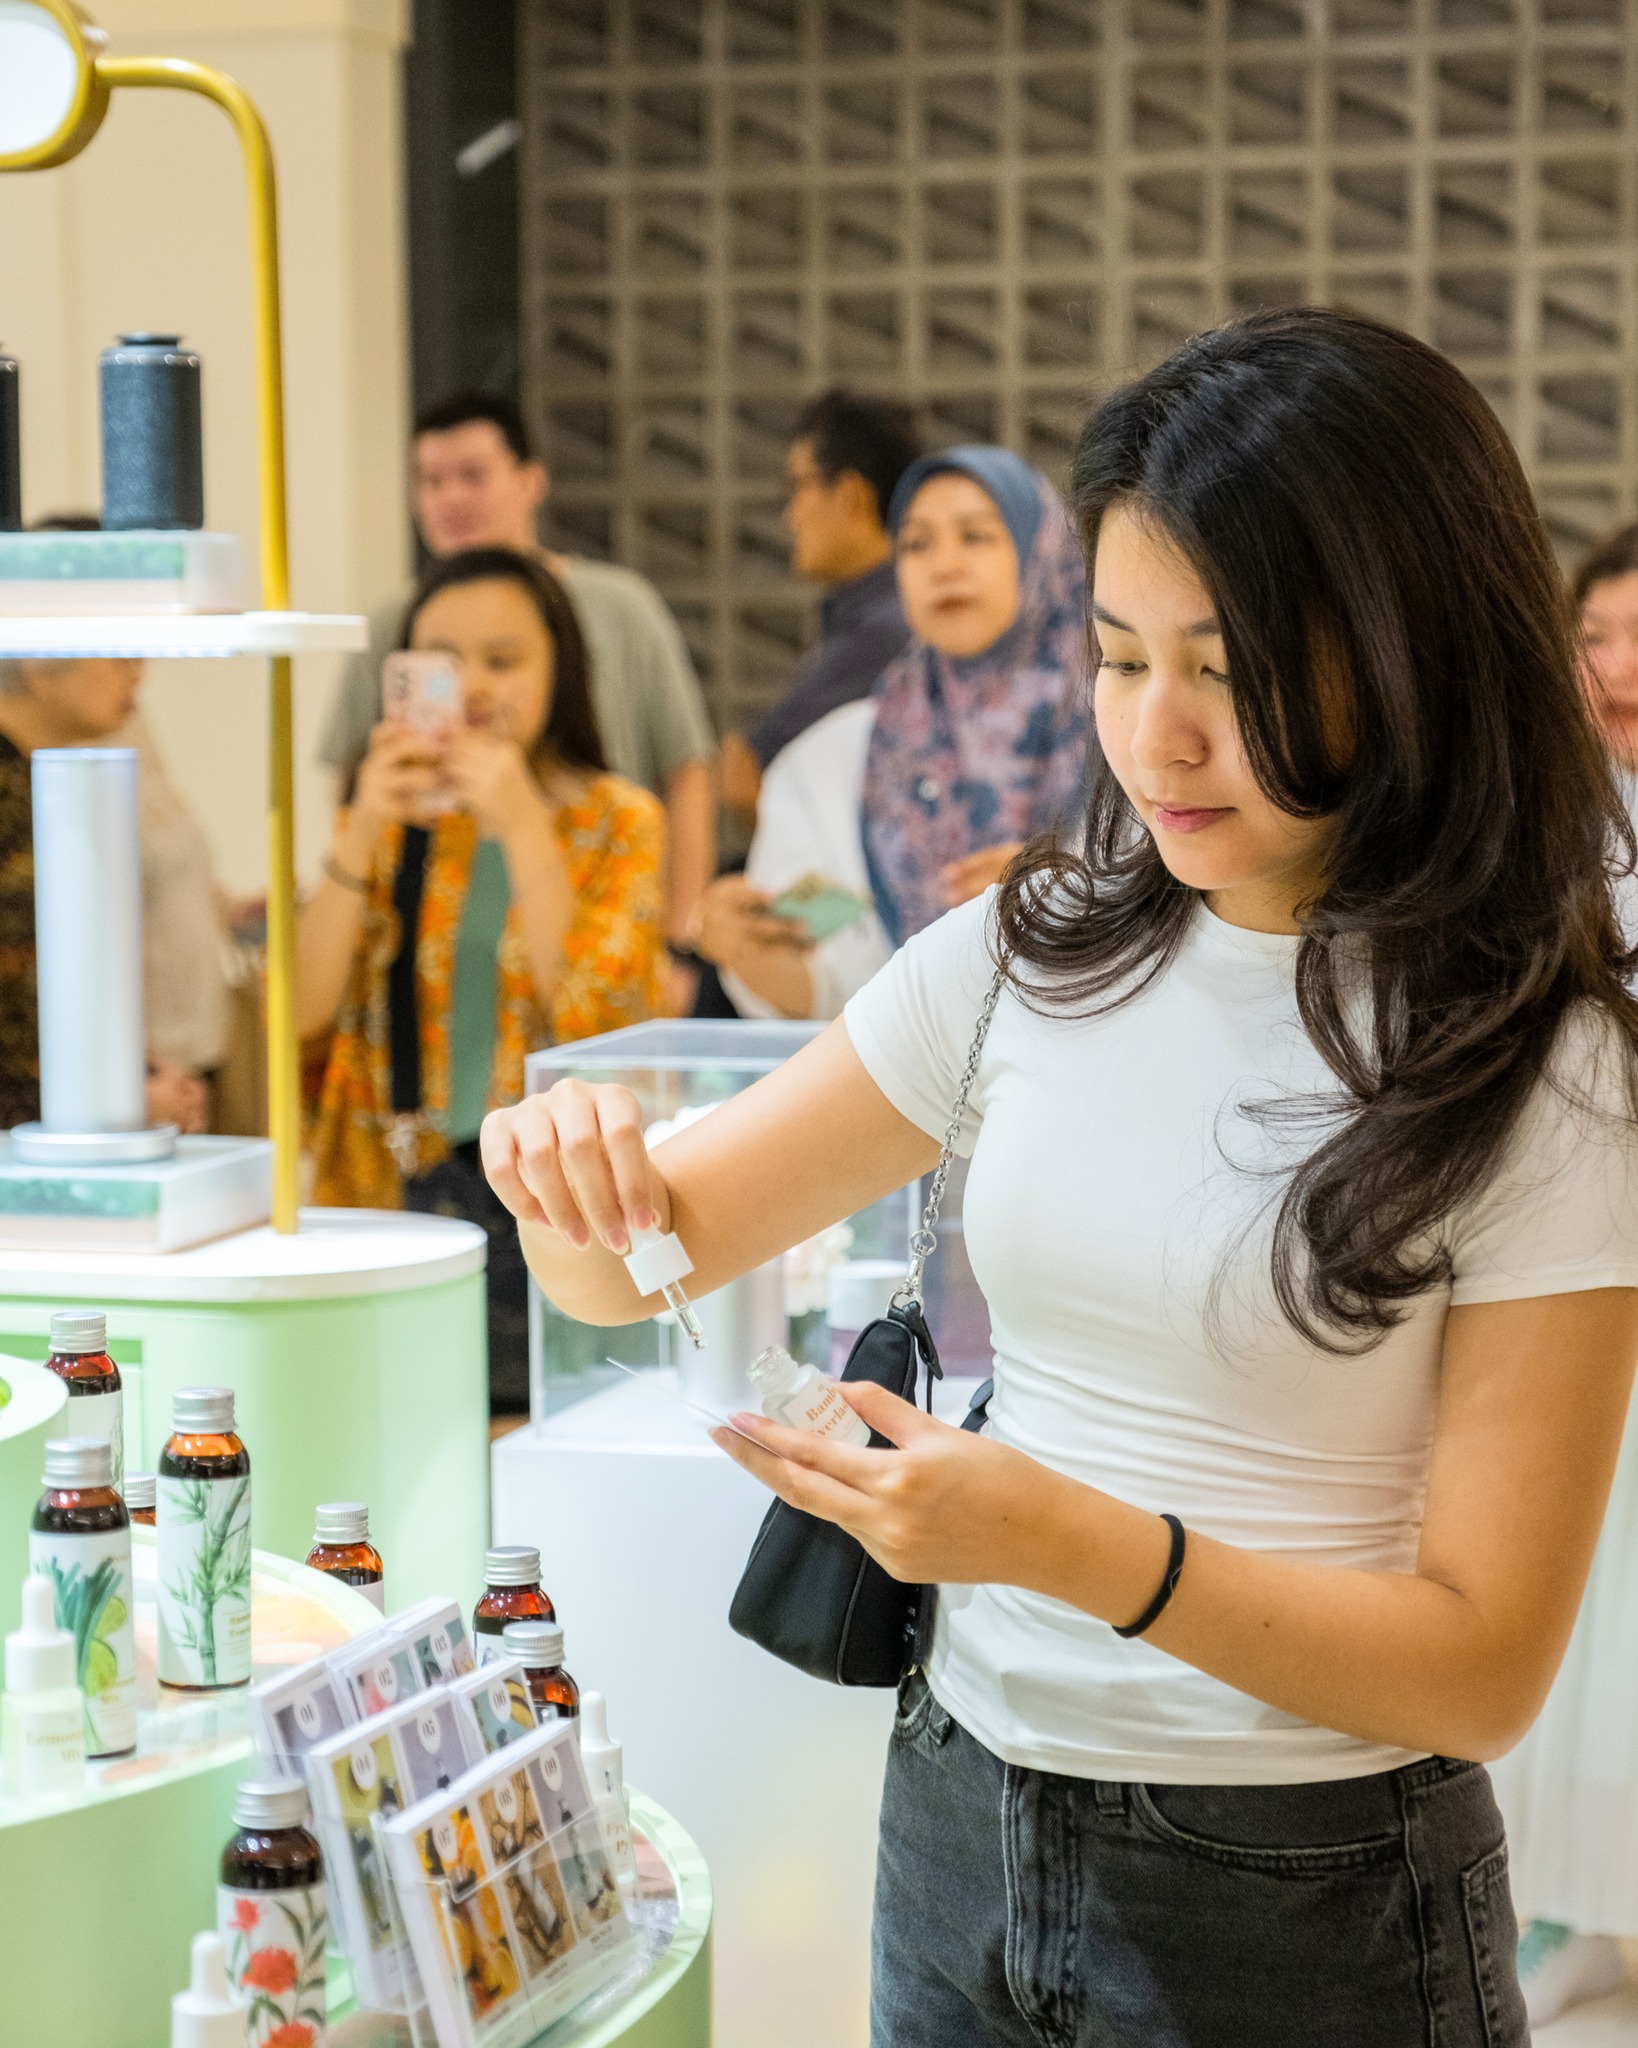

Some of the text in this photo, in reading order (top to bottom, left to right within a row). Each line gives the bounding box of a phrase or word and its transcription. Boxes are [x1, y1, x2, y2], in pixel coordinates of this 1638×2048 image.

[434, 1634, 448, 1655] 03
[378, 1667, 393, 1689] 02
[493, 1688, 507, 1710] 06
[300, 1703, 314, 1725] 01
[422, 1719, 436, 1740] 05
[356, 1754, 371, 1776] 04
[544, 1757, 557, 1777] 09
[500, 1789, 512, 1811] 08
[438, 1827, 450, 1850] 07
